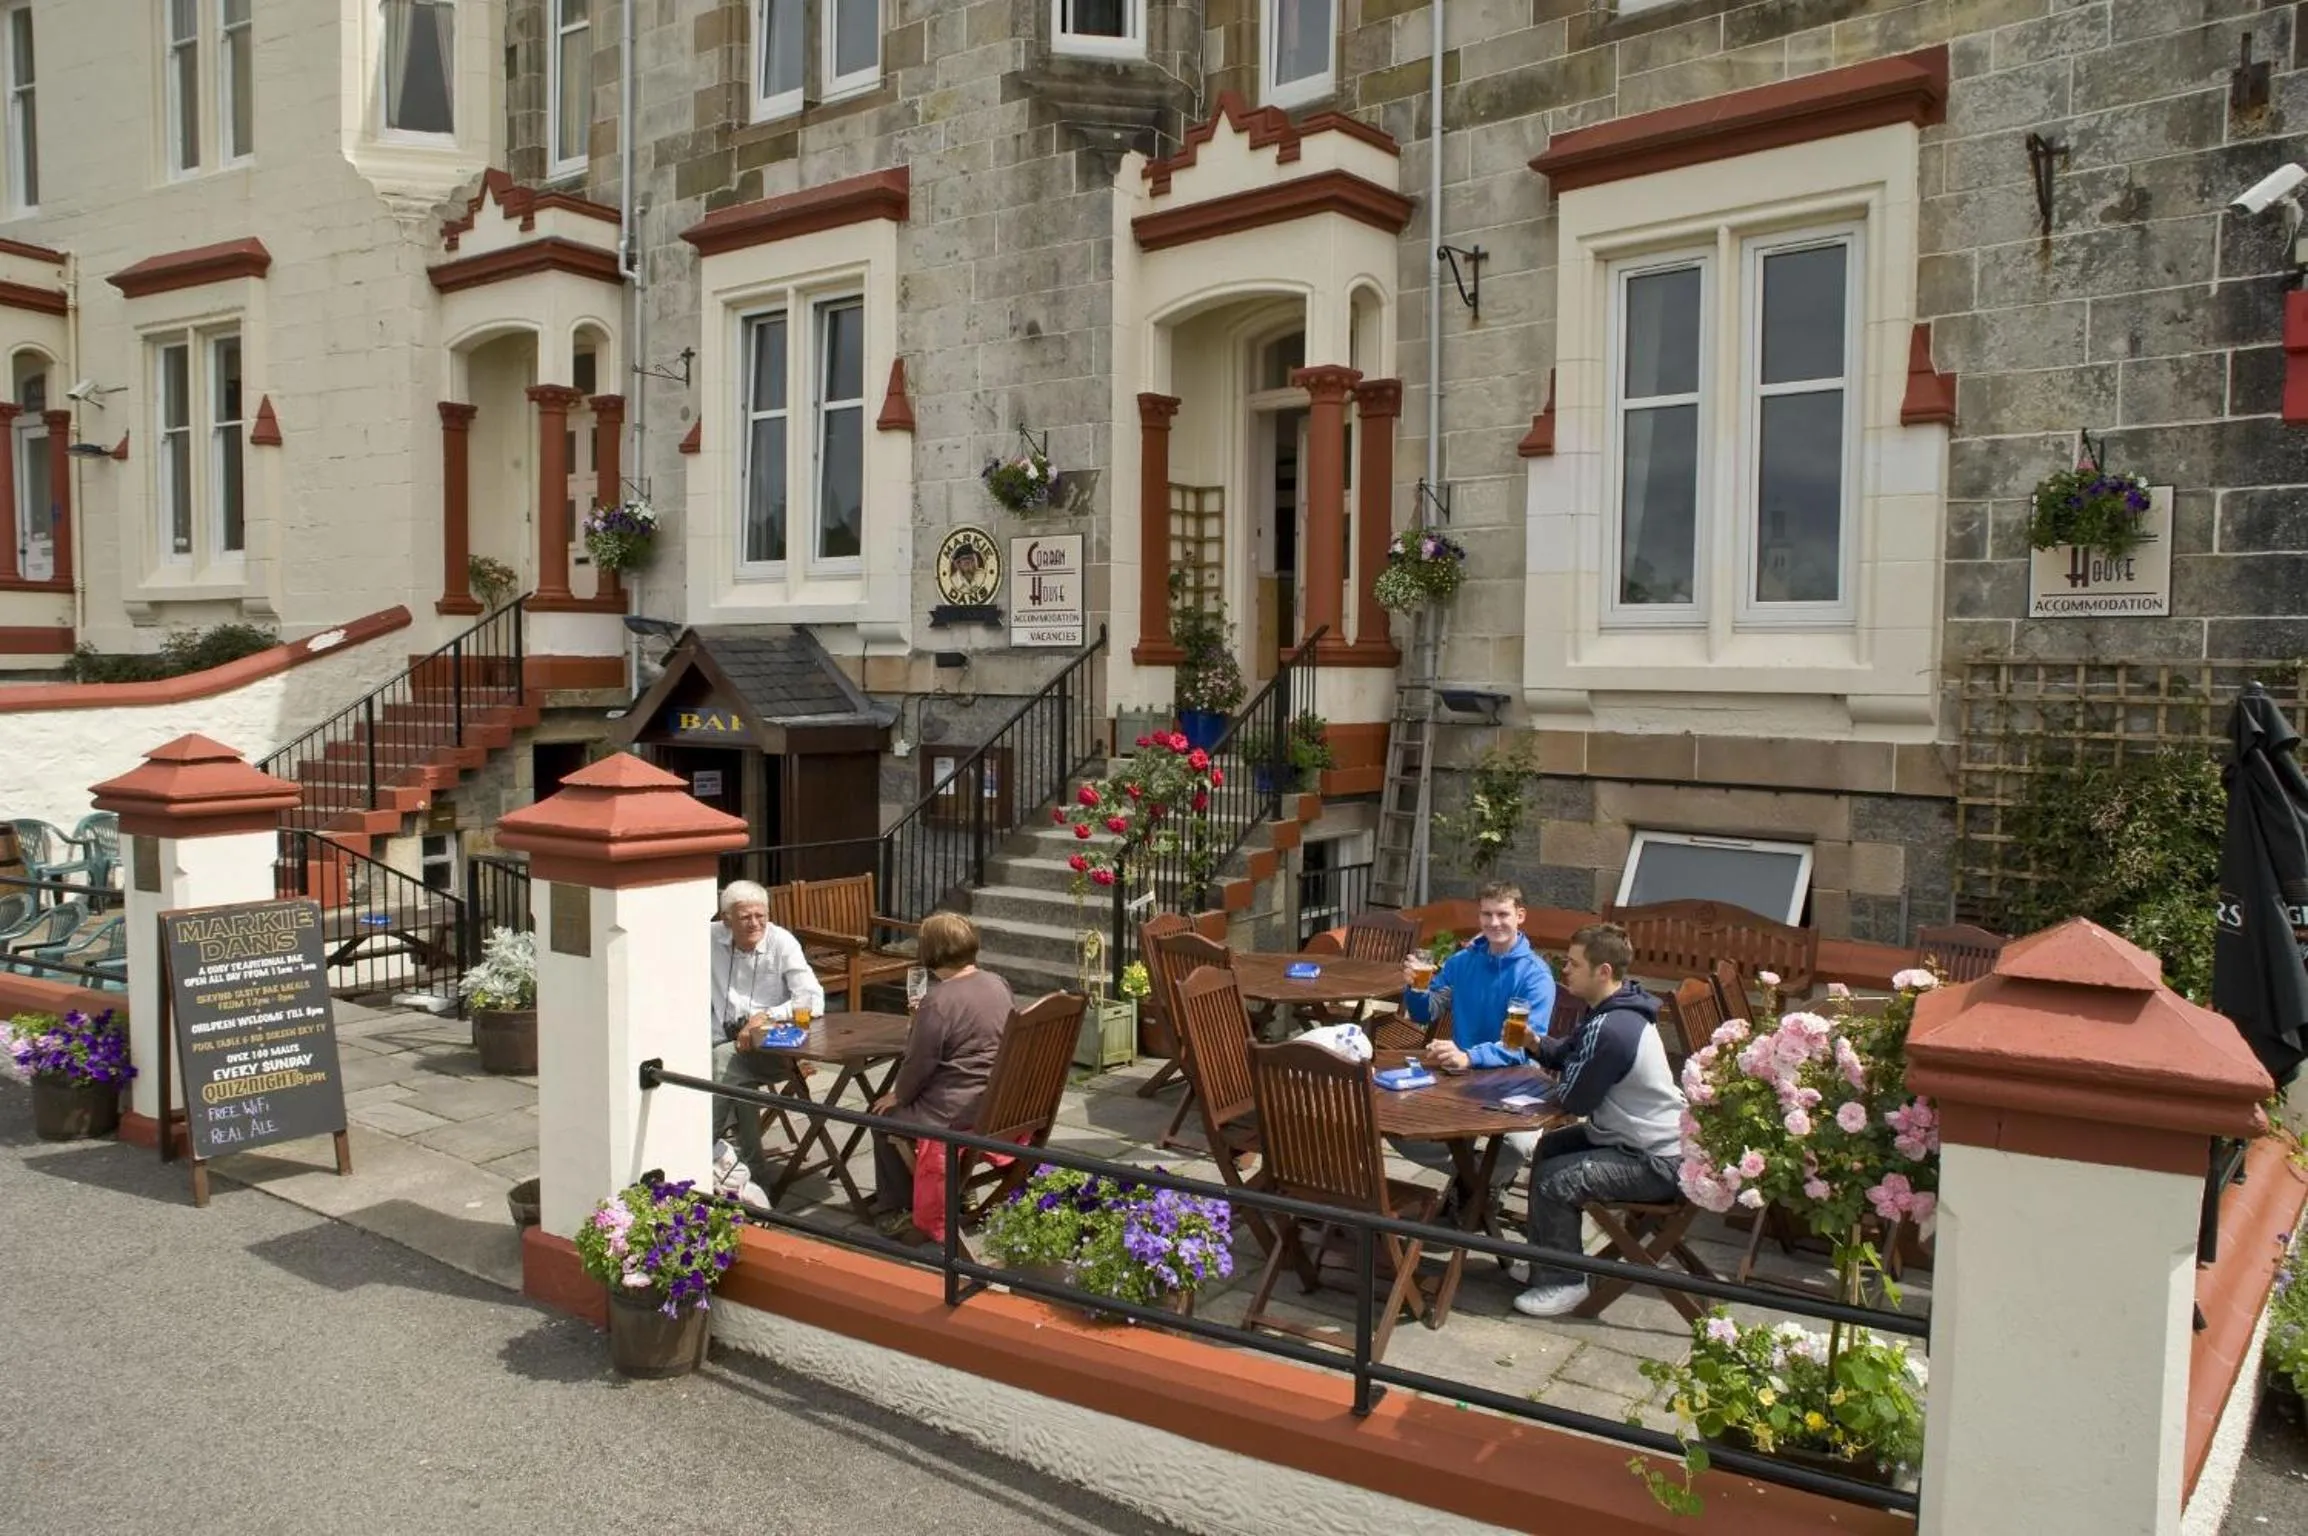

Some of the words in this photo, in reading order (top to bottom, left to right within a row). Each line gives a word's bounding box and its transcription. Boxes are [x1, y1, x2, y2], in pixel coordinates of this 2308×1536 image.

[944, 533, 994, 558] MARKIE
[2064, 546, 2136, 588] HOUSE
[948, 589, 988, 604] DANS
[1029, 576, 1065, 606] HOUSE
[2034, 598, 2163, 612] ACCOMMODATION
[1013, 614, 1080, 623] ACCOMMODATION
[1030, 631, 1077, 642] VACANCIES
[176, 907, 314, 943] MARKIE
[200, 931, 298, 963] DANS
[198, 967, 206, 976] A
[230, 957, 287, 971] TRADITIONAL
[287, 953, 304, 964] BAR
[184, 976, 207, 988] OPEN
[209, 974, 224, 984] ALL
[226, 971, 241, 982] DAY
[242, 967, 270, 979] FROM
[191, 1018, 236, 1034] CHILDREN
[237, 1010, 285, 1028] WELCOME
[286, 1007, 305, 1020] TILL
[191, 1041, 215, 1053] POOL
[215, 1036, 242, 1049] TABLE
[265, 1027, 297, 1041] SCREEN
[297, 1025, 315, 1036] SKY
[315, 1022, 327, 1033] TV
[227, 1051, 250, 1063] OVER
[270, 1043, 301, 1056] MALTS
[213, 1062, 259, 1081] EVERY
[262, 1053, 313, 1073] SUNDAY
[203, 1078, 247, 1104] QUIZ
[247, 1069, 299, 1094] NIGHT
[209, 1105, 241, 1121] FREE
[211, 1126, 245, 1144] REAL
[250, 1119, 279, 1138] ALE
